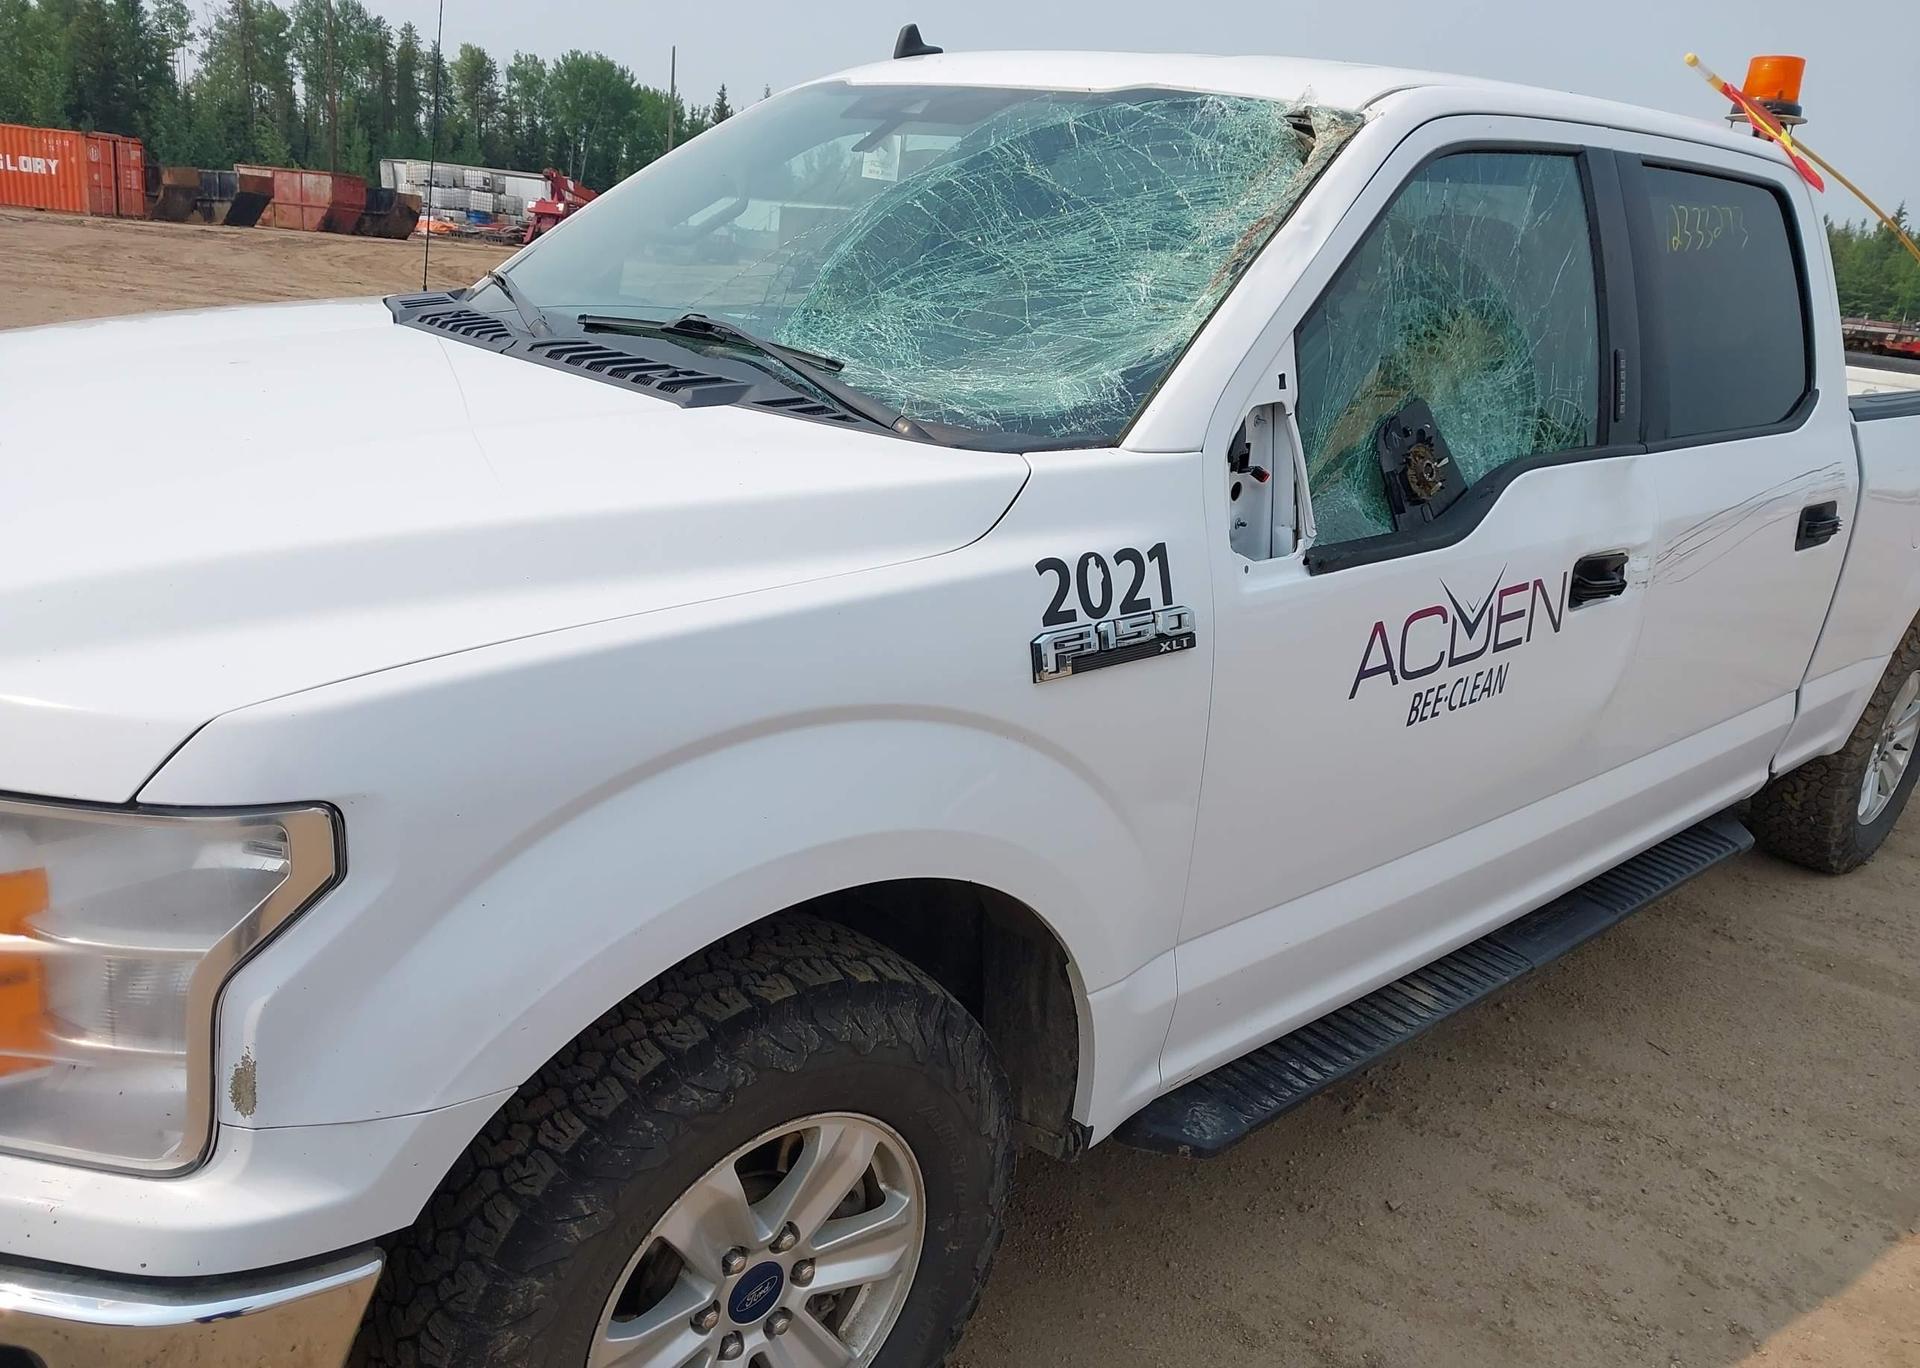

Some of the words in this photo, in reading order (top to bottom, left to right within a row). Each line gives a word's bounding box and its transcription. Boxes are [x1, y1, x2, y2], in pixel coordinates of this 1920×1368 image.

[1034, 542, 1173, 627] 2021
[1159, 636, 1191, 653] XLT
[746, 1282, 771, 1308] Ford
